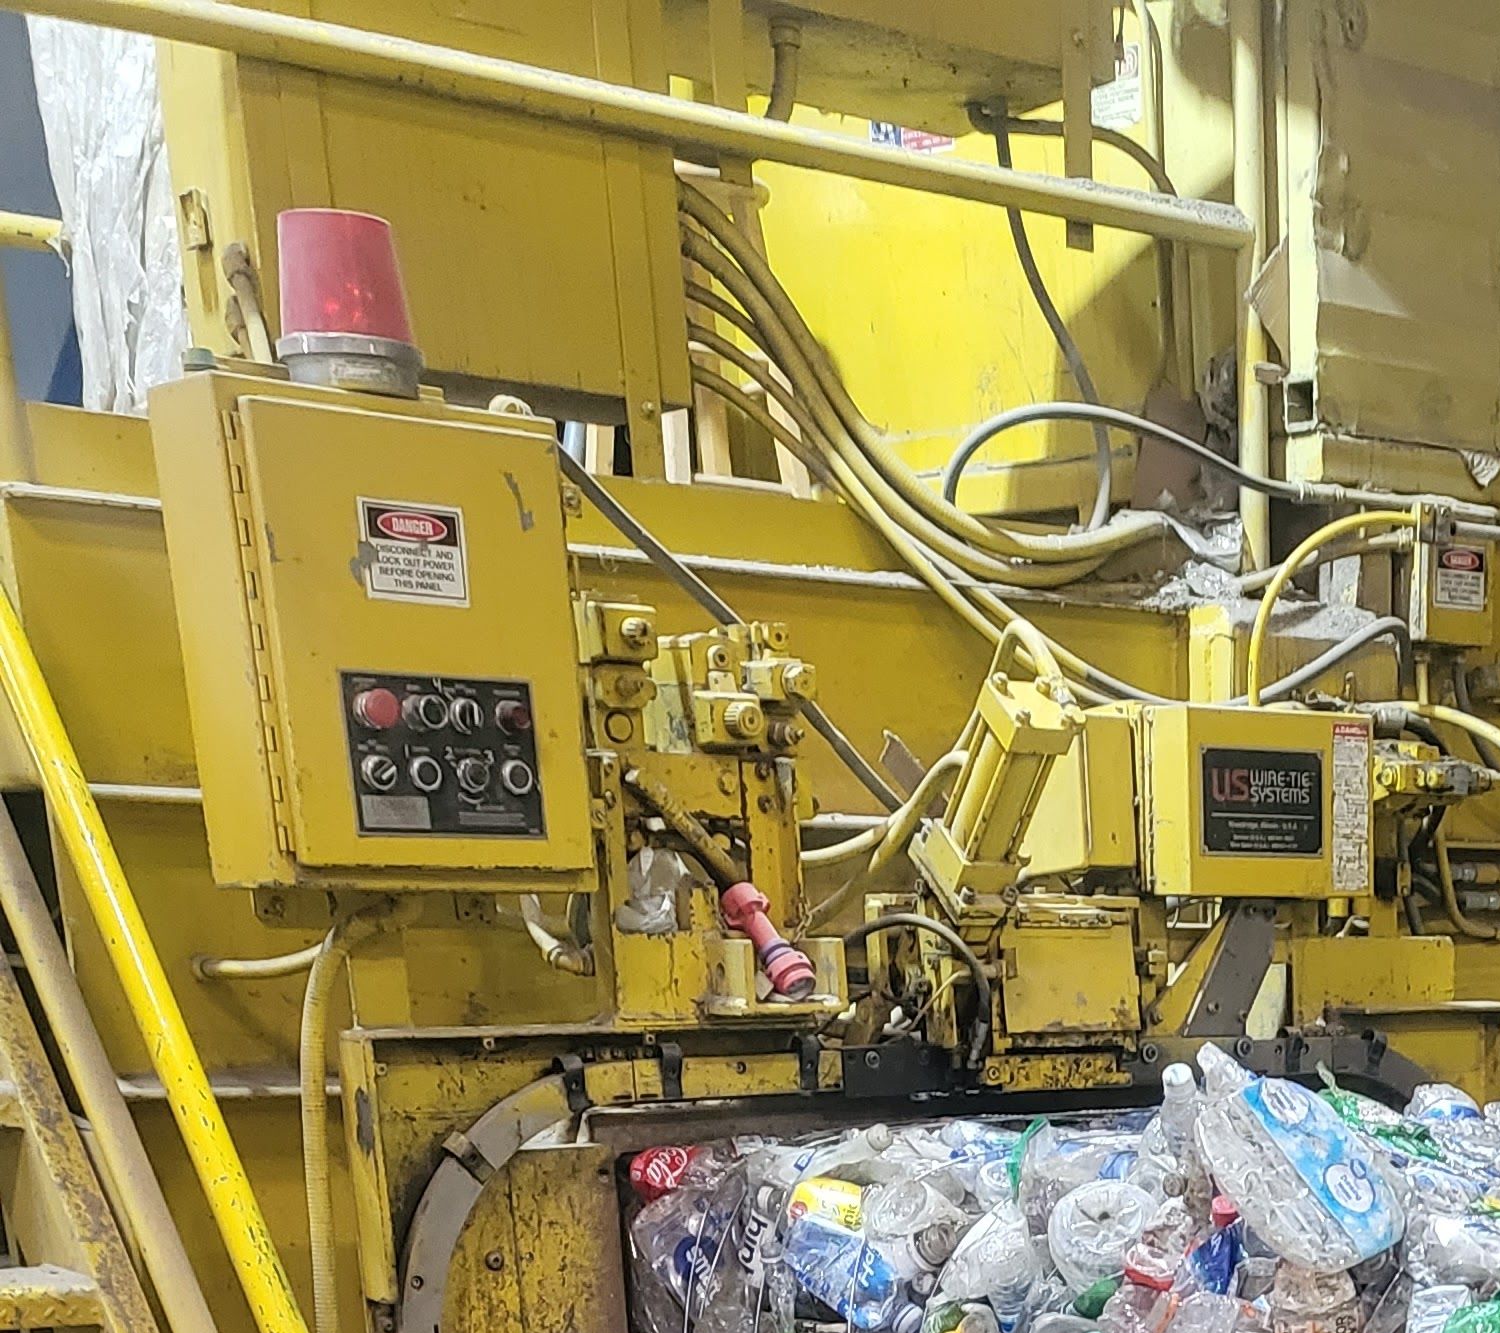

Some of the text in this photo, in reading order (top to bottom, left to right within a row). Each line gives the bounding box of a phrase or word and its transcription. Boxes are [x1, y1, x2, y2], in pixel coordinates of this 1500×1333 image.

[392, 516, 434, 536] DANGER
[377, 544, 454, 560] DISCONNECT AND
[377, 554, 455, 570] LOCK OUT POWER
[379, 565, 456, 582] BEFORE OPENING
[394, 579, 443, 593] THIS PANEL
[1212, 768, 1249, 805] US
[1250, 788, 1310, 805] SYSTEMS
